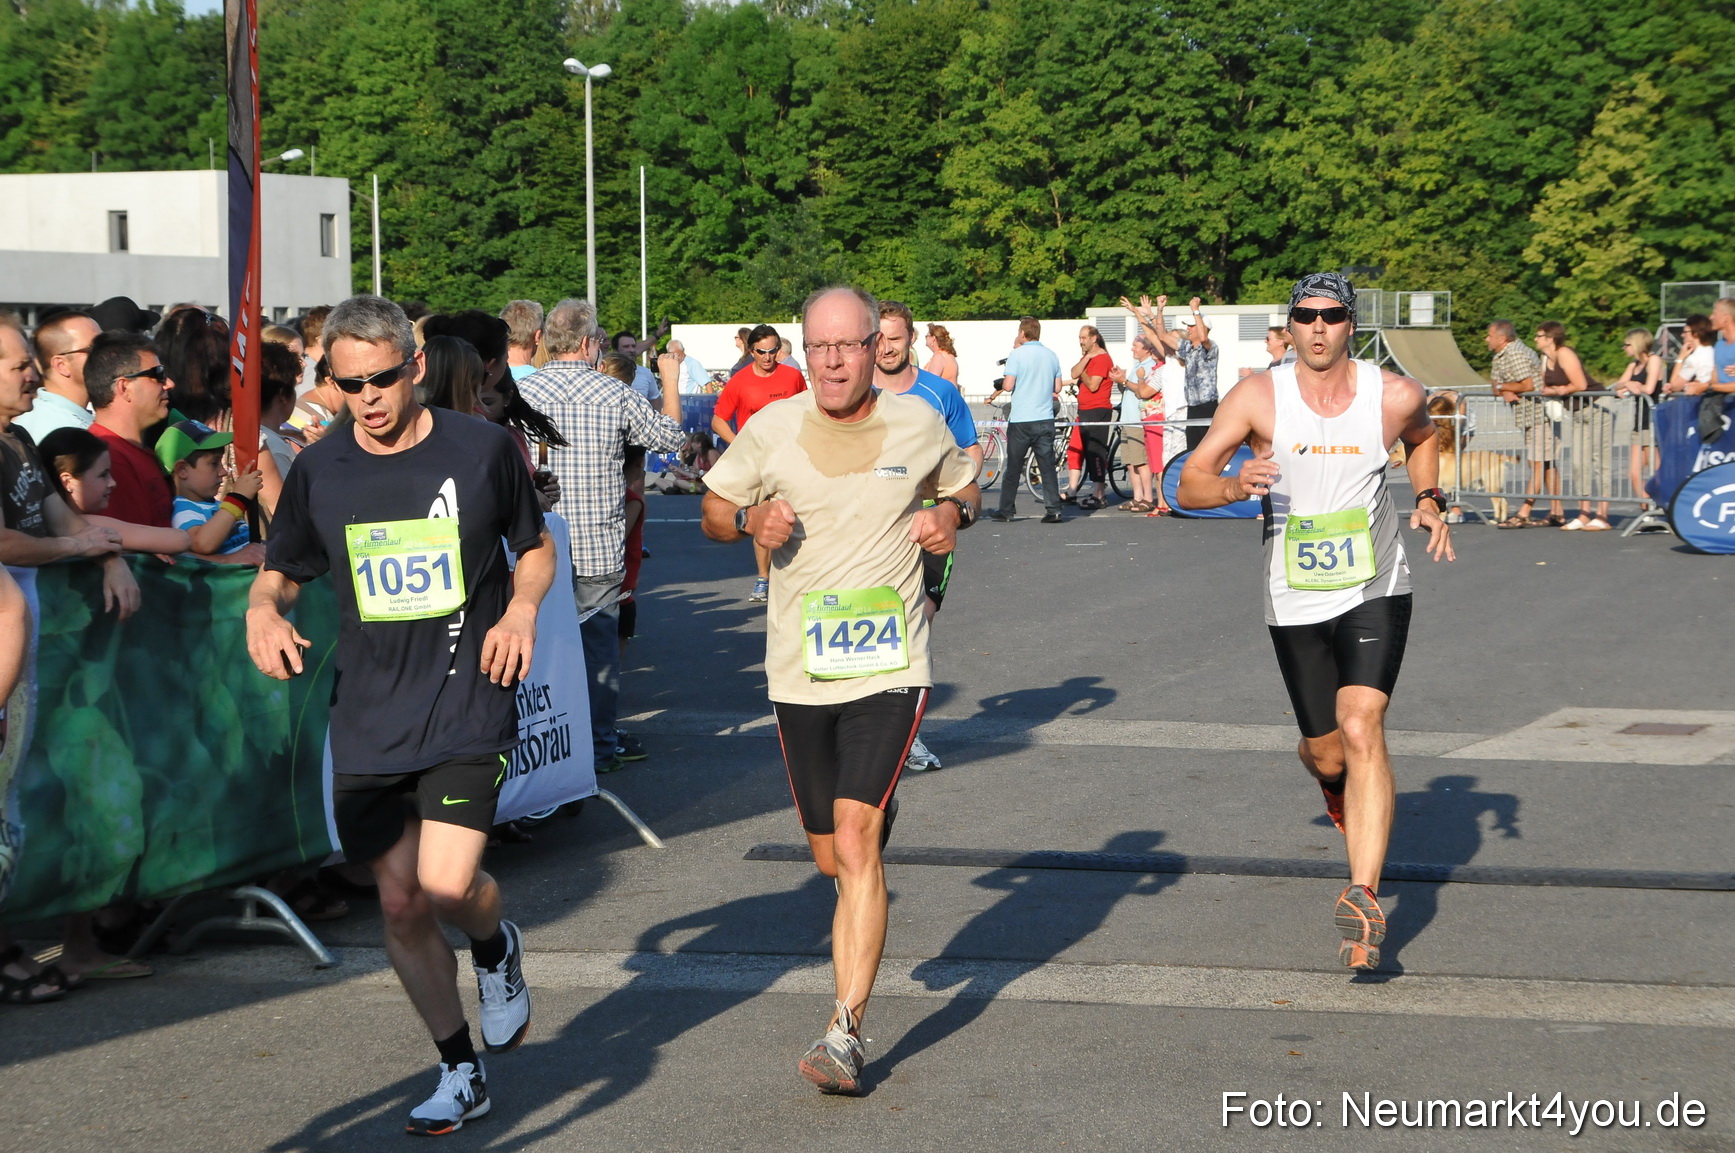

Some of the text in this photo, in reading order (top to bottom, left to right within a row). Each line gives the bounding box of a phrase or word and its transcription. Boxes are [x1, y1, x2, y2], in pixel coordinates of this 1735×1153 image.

[1311, 445, 1364, 454] KLEBL
[364, 537, 401, 548] firmenlauf
[1297, 537, 1354, 571] 531
[356, 552, 452, 597] 1051
[389, 595, 429, 605] Ludwig Friedl
[413, 603, 432, 611] GmbH
[806, 615, 902, 656] 1424
[516, 682, 552, 719] rkter
